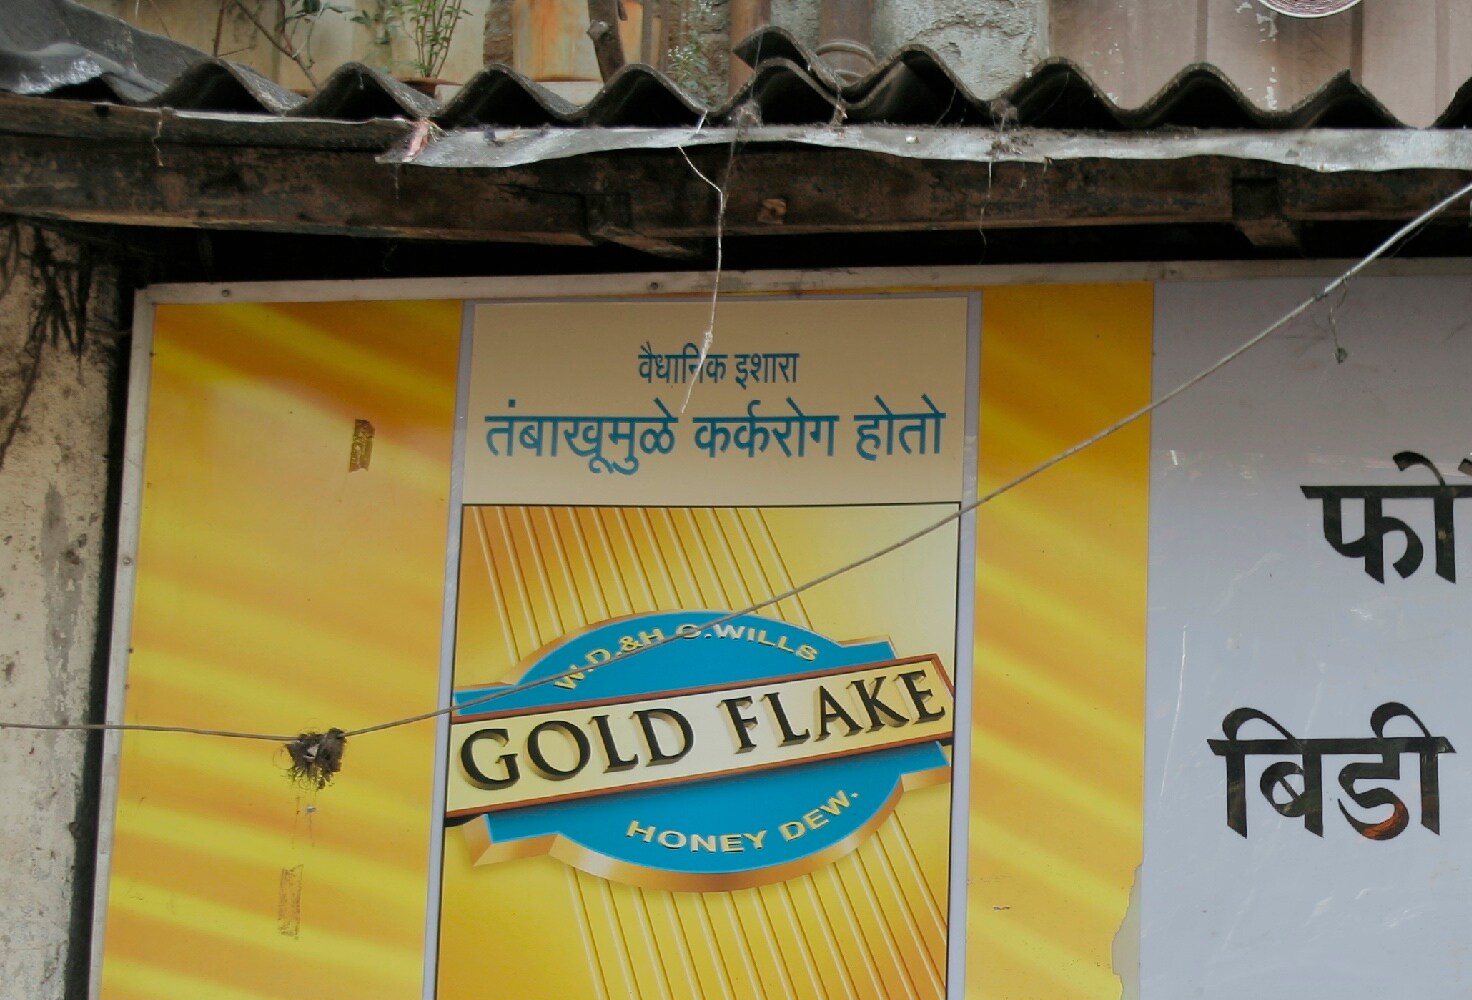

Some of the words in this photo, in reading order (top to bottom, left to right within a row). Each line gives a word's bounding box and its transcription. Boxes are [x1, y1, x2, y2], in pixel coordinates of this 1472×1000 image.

[735, 352, 800, 389] इशारा
[485, 398, 679, 475] तंबाखूमुळे
[693, 397, 839, 458] कर्करोग
[854, 394, 946, 461] होतो
[460, 706, 694, 790] GOLD
[717, 669, 946, 753] FLAKE
[1207, 701, 1456, 840] बिडी
[626, 820, 766, 853] HONEY
